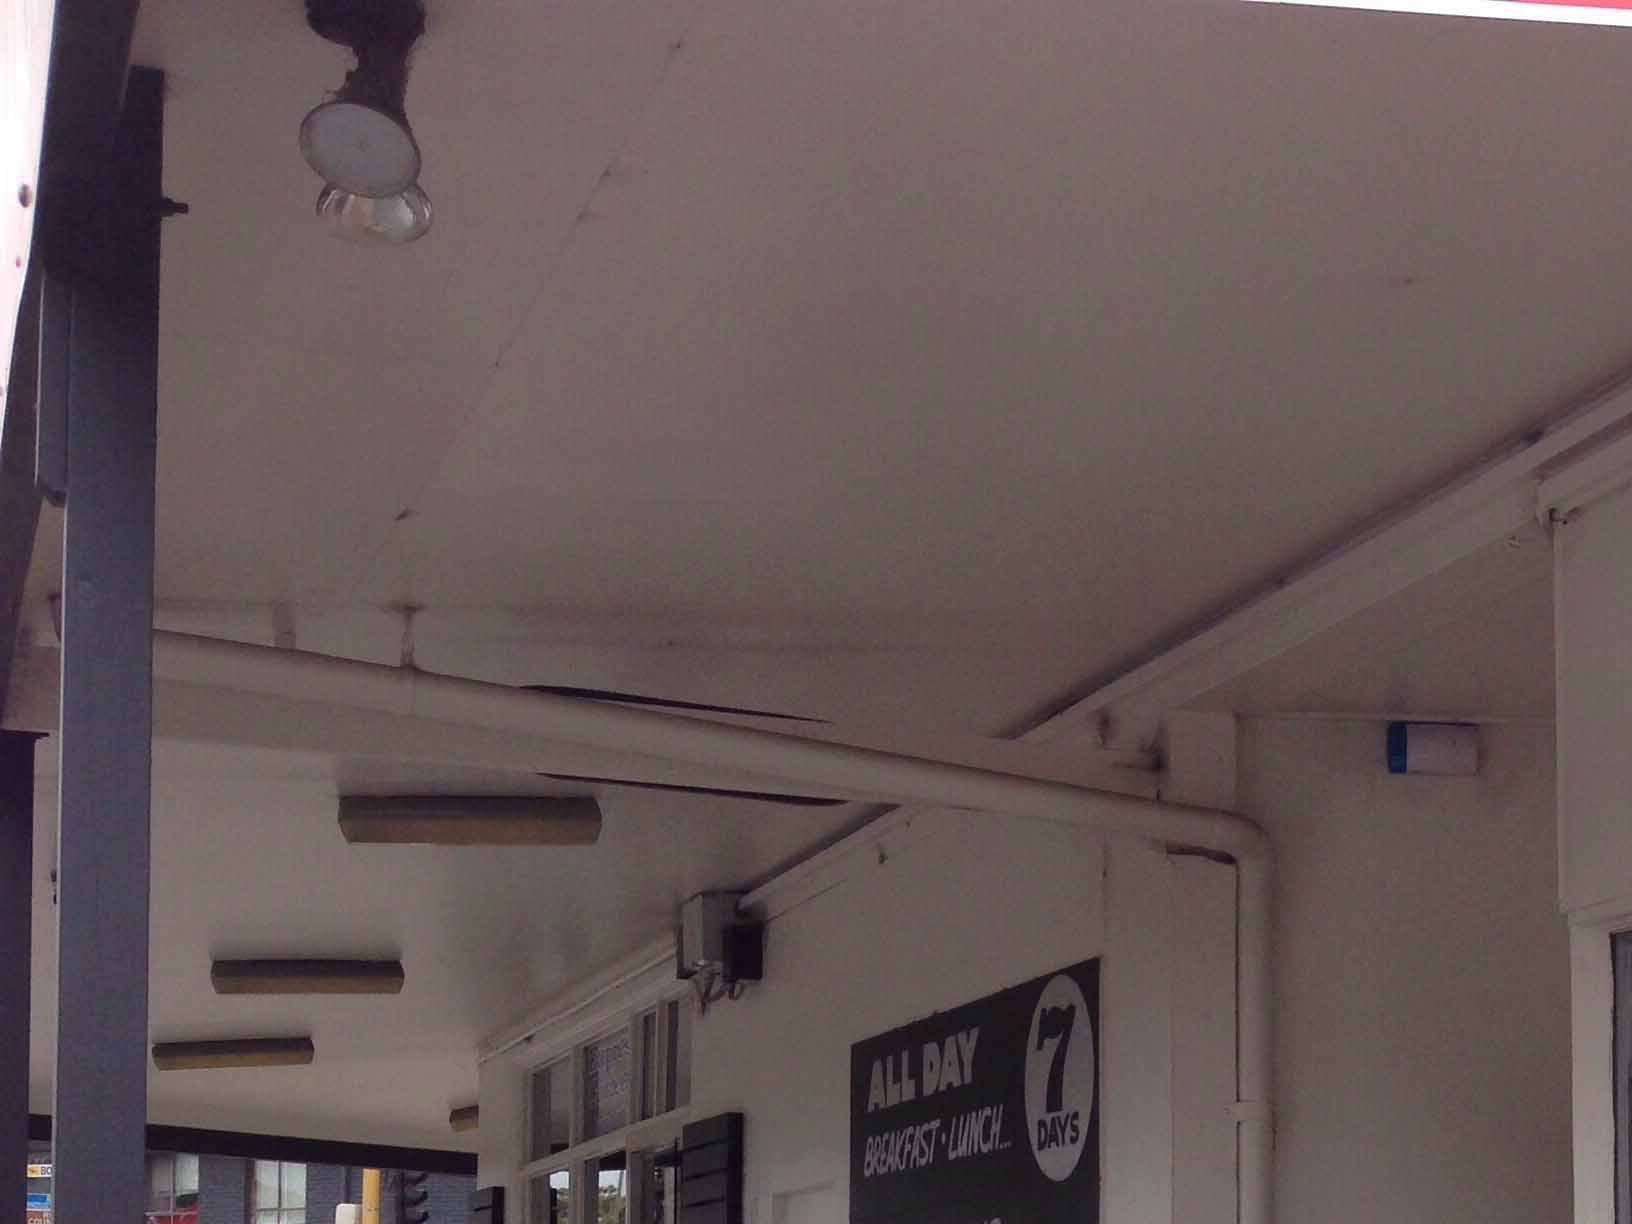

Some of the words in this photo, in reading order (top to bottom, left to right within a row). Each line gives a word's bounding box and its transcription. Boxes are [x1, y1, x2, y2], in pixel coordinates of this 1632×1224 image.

[867, 1050, 916, 1113] ALL
[922, 1027, 980, 1097] DAY
[1037, 1003, 1076, 1114] 7
[863, 1119, 941, 1178] BREAKFAST
[1037, 1111, 1081, 1151] DAYS
